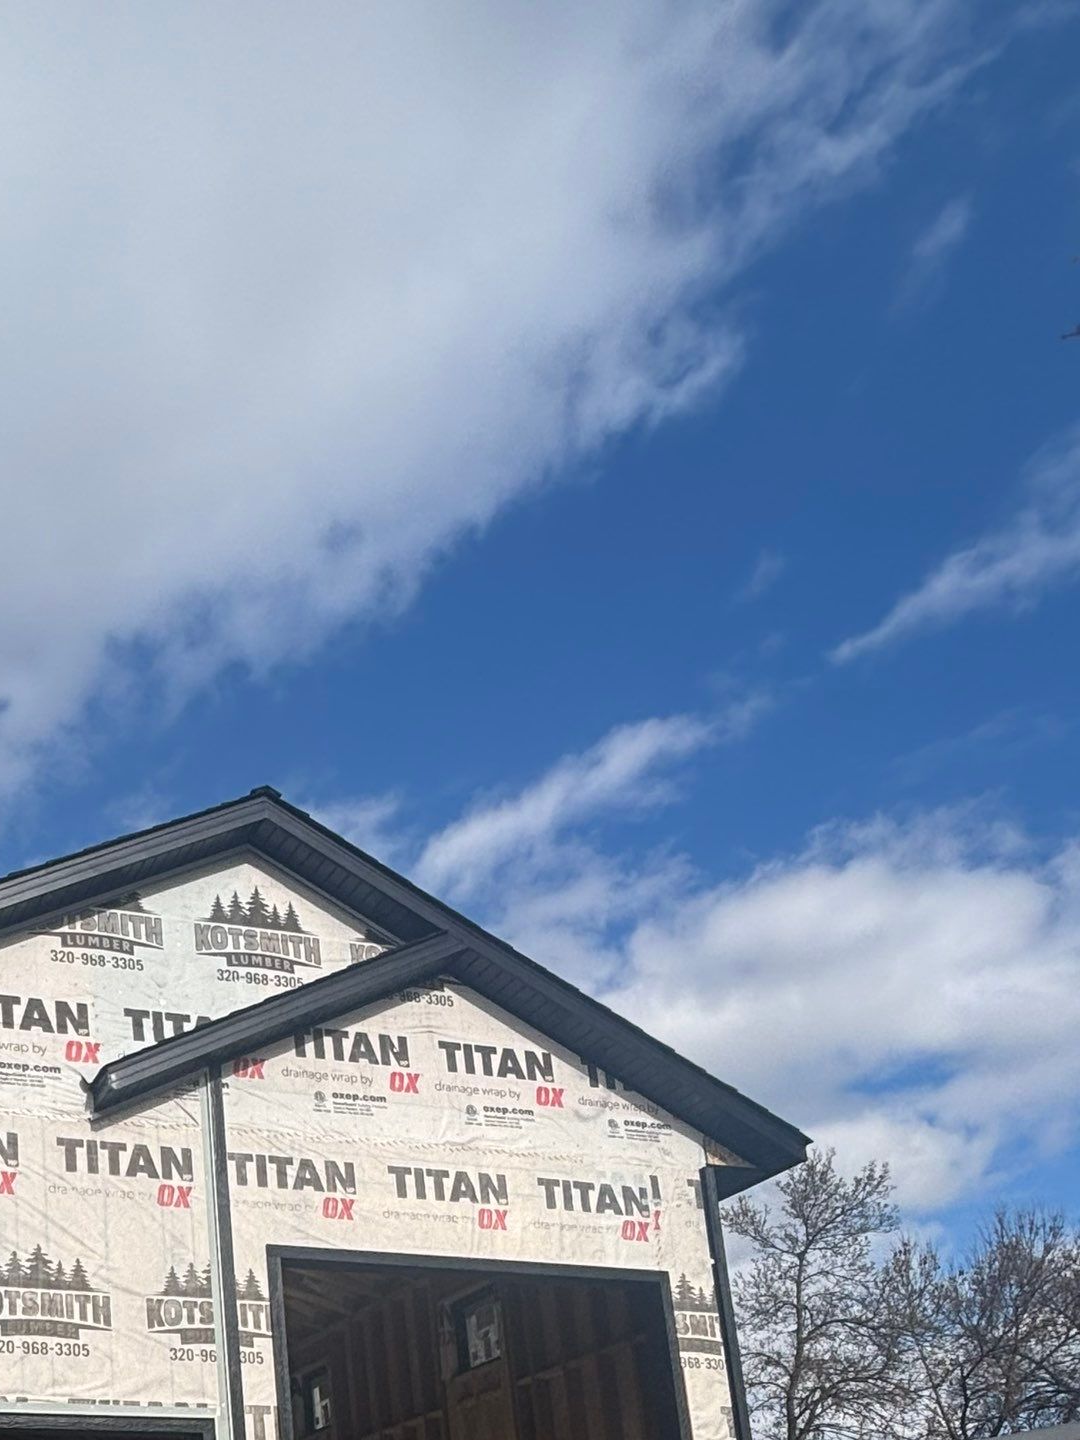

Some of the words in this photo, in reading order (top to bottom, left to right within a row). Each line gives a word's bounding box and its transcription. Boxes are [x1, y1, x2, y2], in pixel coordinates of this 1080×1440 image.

[67, 934, 132, 953] LUMBER
[194, 923, 322, 966] KOTSMITH
[50, 949, 144, 972] 320-968-3305
[232, 954, 293, 972] LUMBER
[217, 968, 304, 988] 320-968-3305
[32, 1042, 47, 1056] by
[65, 1040, 101, 1064] OX
[294, 1027, 411, 1068] TITAN
[0, 1061, 62, 1075] oxep.com
[232, 1056, 267, 1080] OX
[438, 1040, 555, 1083] TITAN
[281, 1067, 329, 1082] drainage
[331, 1073, 358, 1085] wrap
[361, 1074, 373, 1088] by
[389, 1071, 420, 1094] OX
[331, 1092, 387, 1103] oxep.com
[435, 1081, 480, 1096] drainage
[482, 1088, 507, 1099] wrap
[509, 1087, 521, 1101] by
[536, 1086, 565, 1108] OX
[577, 1096, 620, 1111] drainage
[622, 1102, 646, 1114] wrap
[483, 1105, 535, 1116] oxep.com
[624, 1119, 672, 1130] oxep.com
[57, 1137, 194, 1182] TITAN
[228, 1152, 357, 1195] TITAN
[387, 1165, 508, 1206] TITAN
[157, 1184, 193, 1209] OX
[536, 1177, 650, 1218] TITAN
[322, 1197, 356, 1221] OX
[478, 1208, 508, 1231] OX
[621, 1219, 650, 1242] OX
